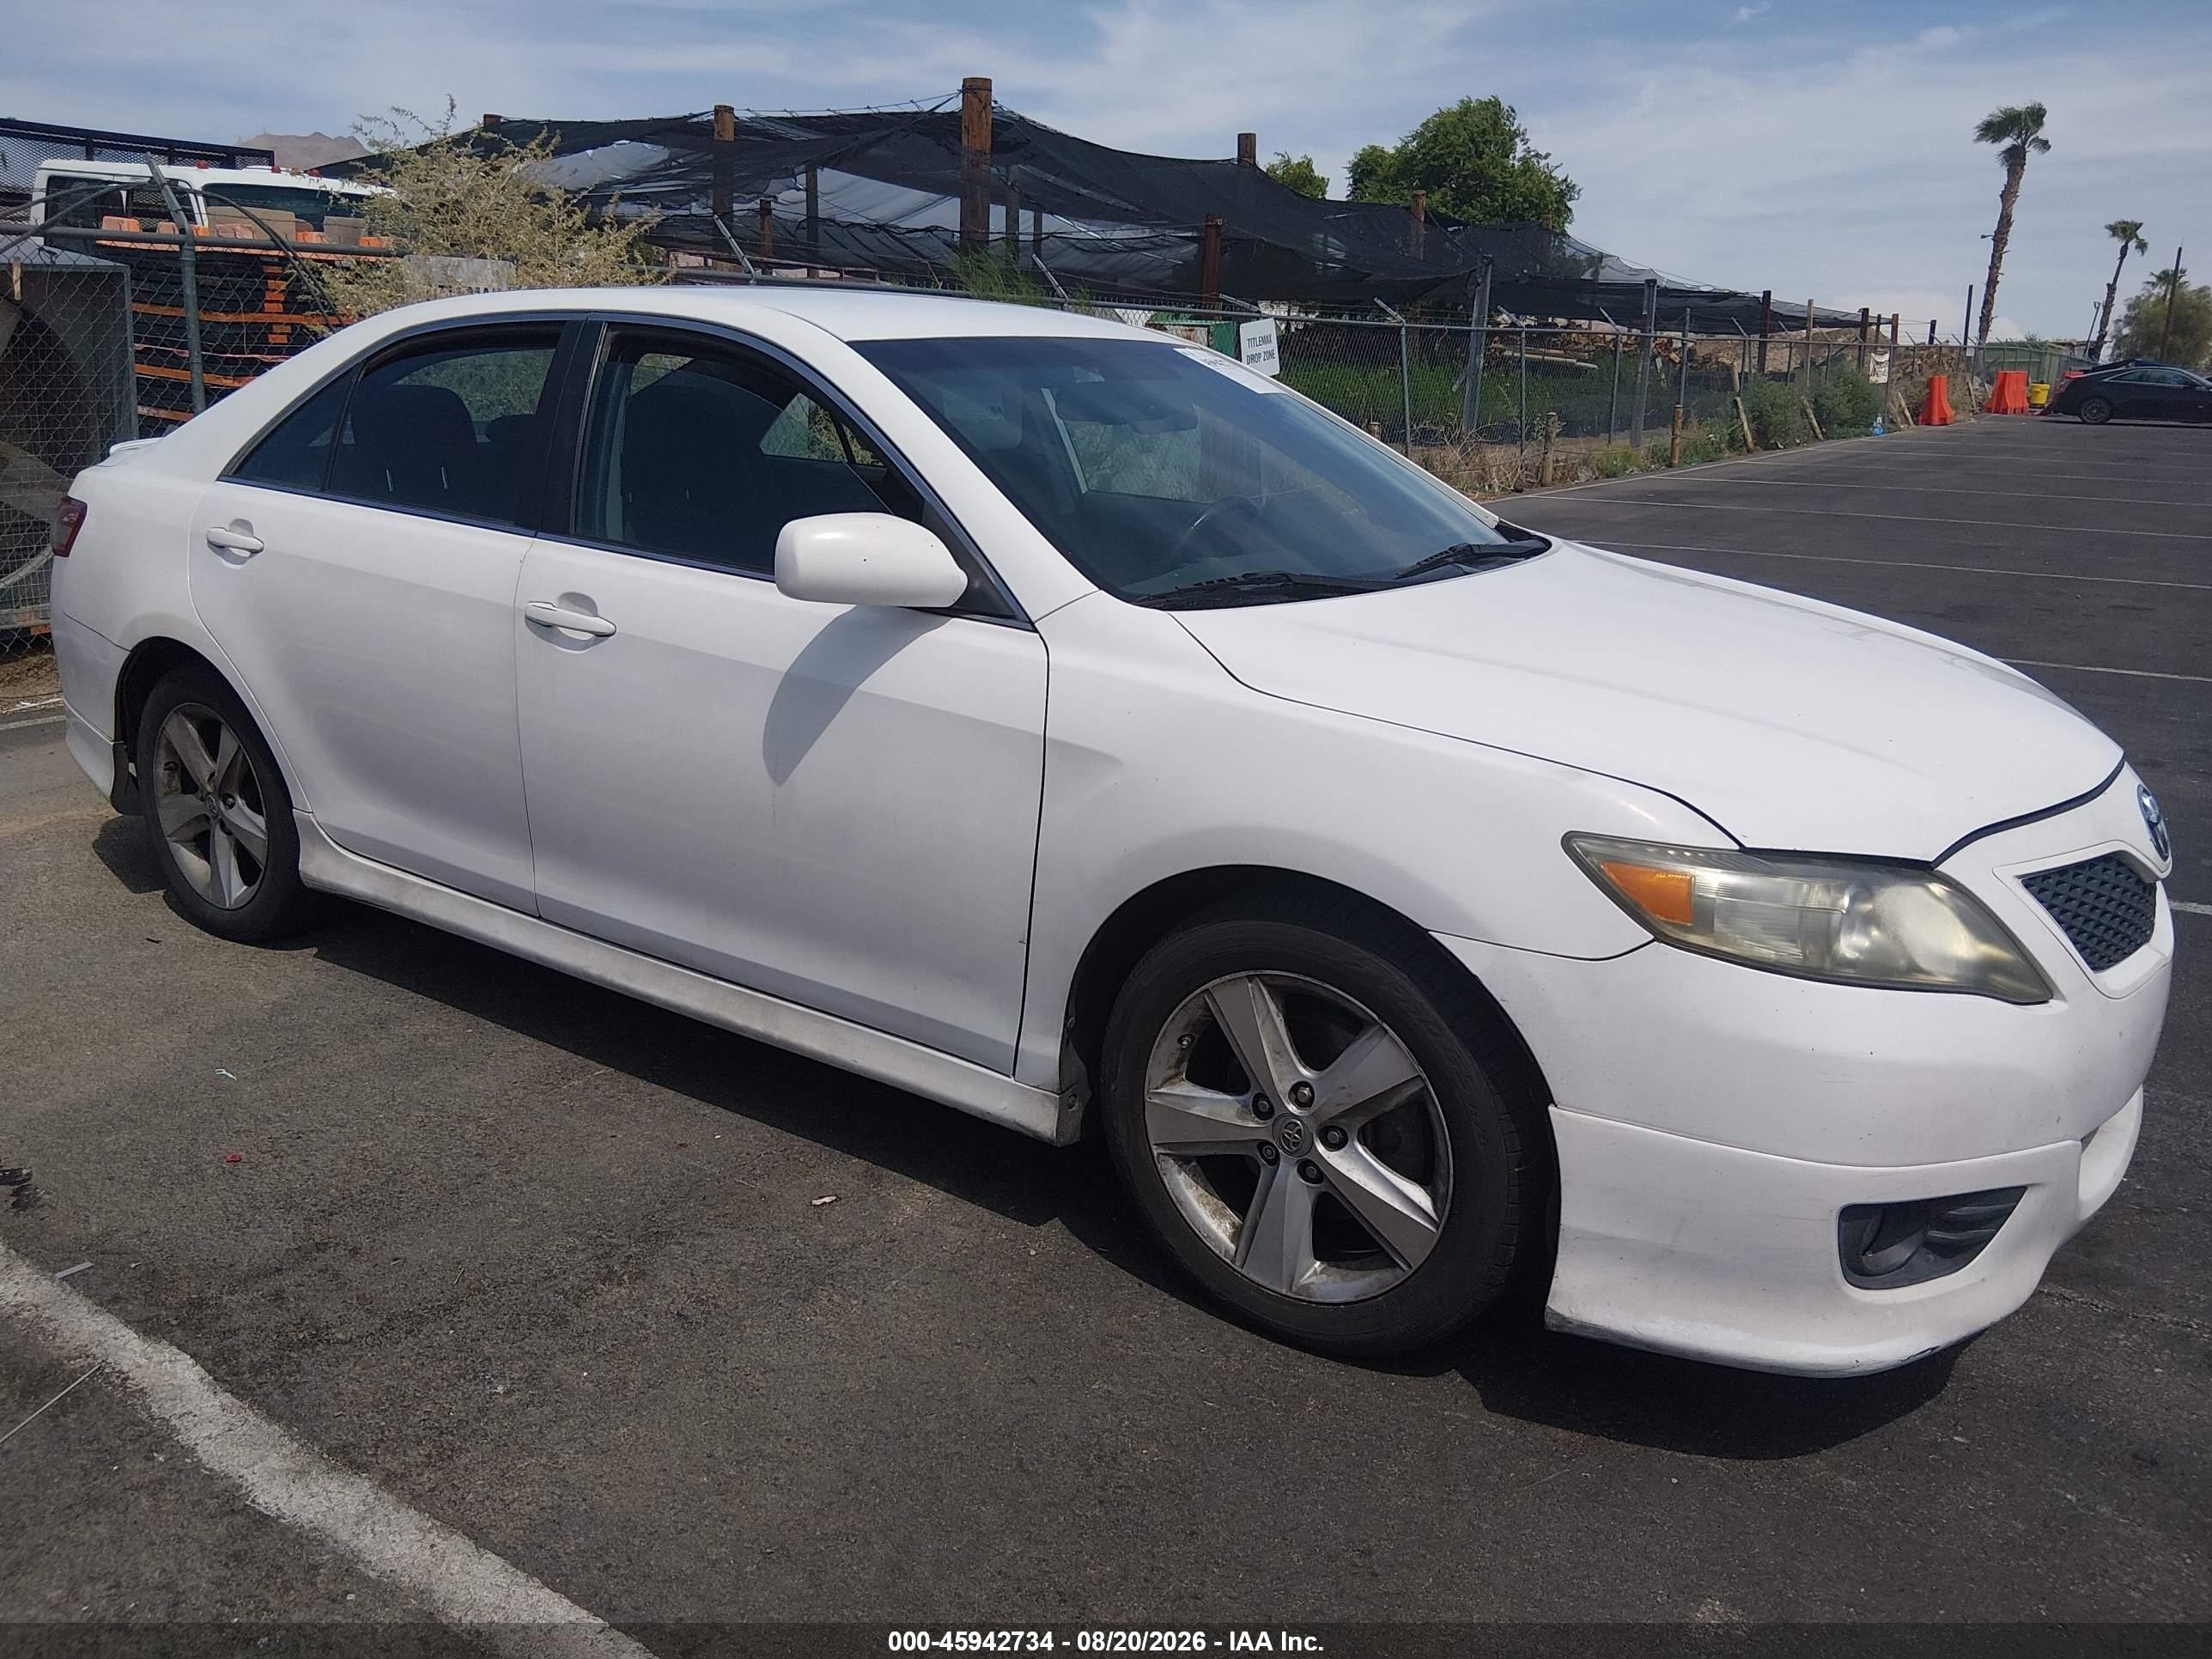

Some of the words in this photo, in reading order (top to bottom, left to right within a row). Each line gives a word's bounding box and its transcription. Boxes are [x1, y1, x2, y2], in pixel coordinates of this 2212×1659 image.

[1247, 334, 1273, 349] TITLEMAX
[1246, 352, 1261, 365] DROP
[1263, 349, 1275, 361] ZONE
